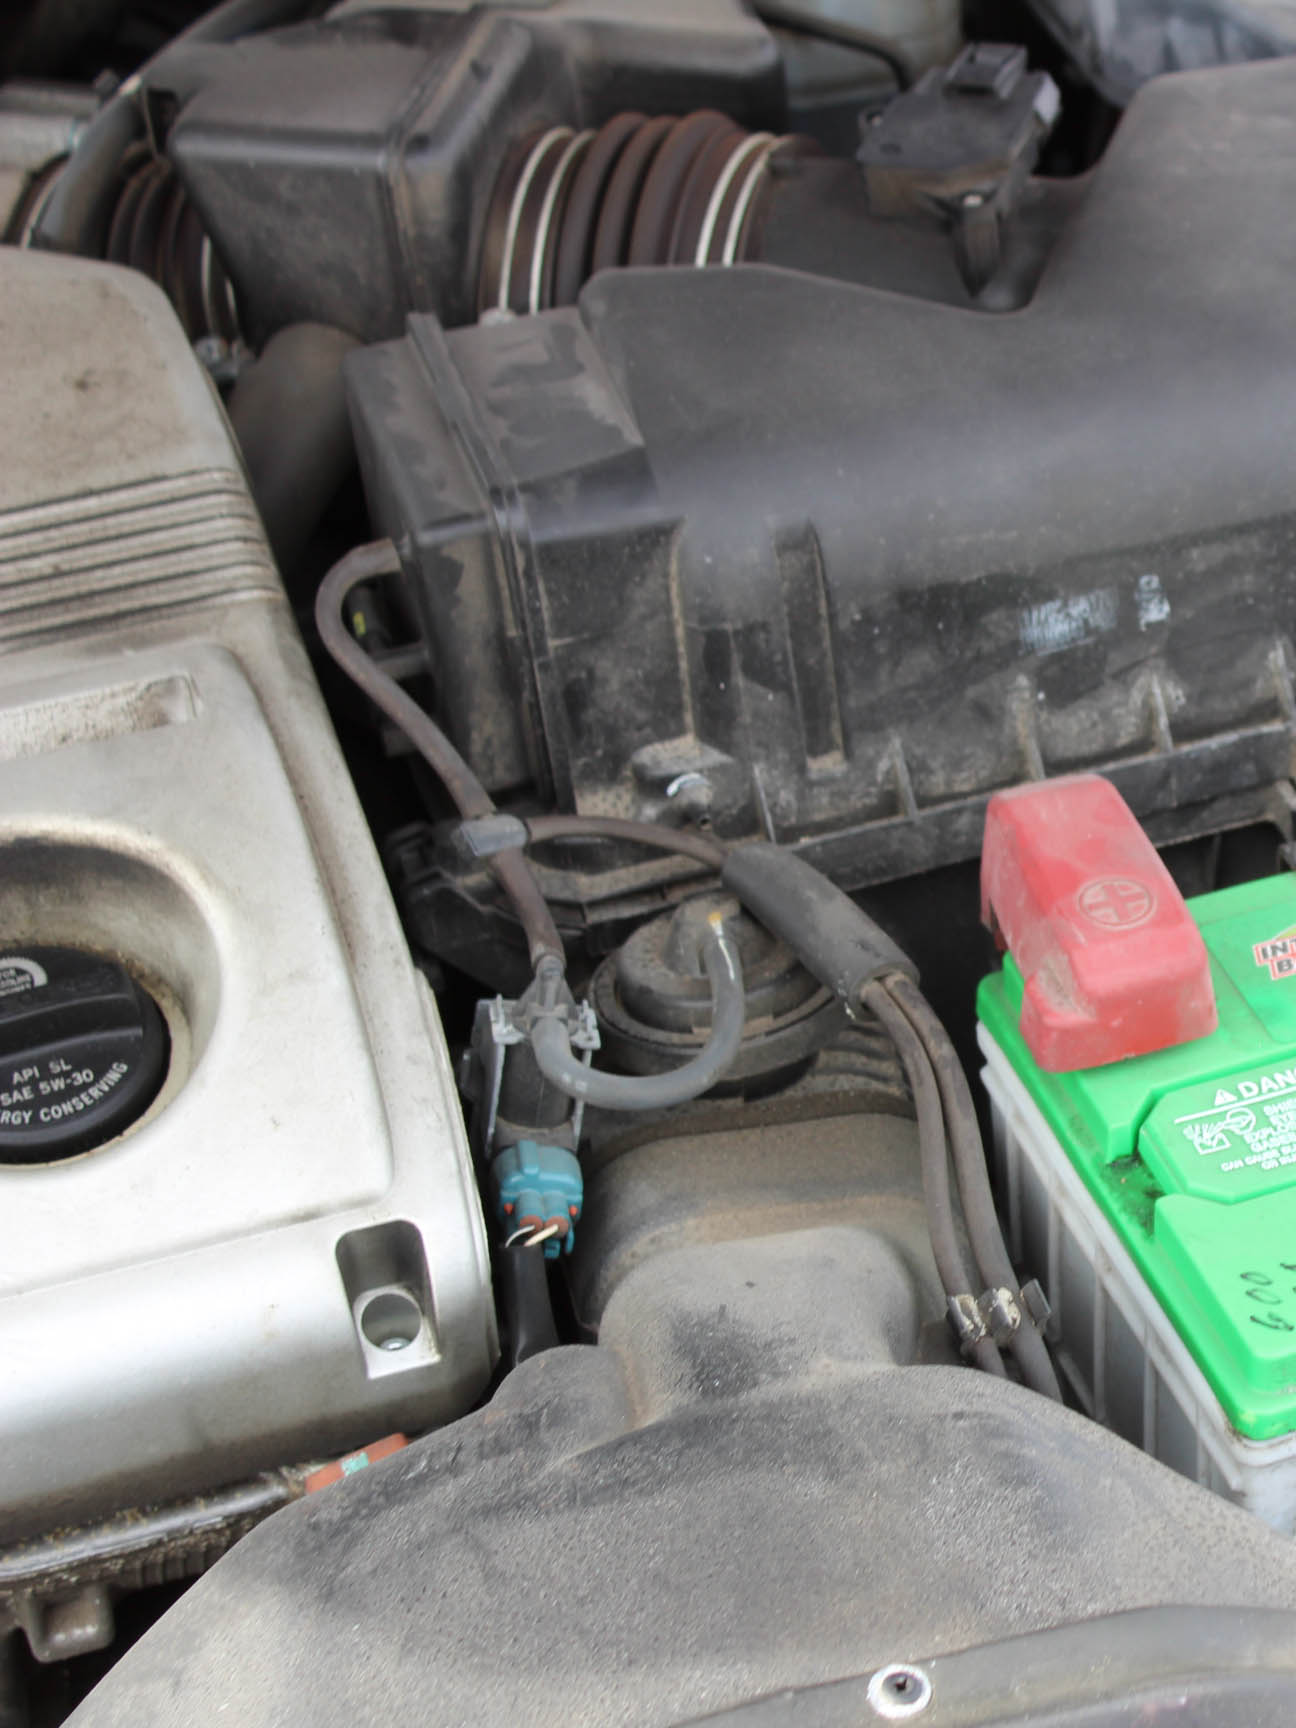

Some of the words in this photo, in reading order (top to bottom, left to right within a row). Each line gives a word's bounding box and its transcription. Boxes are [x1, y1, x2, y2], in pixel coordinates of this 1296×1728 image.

[0, 1085, 34, 1107] SAE
[39, 1068, 94, 1095] 5W-30
[12, 1065, 40, 1085] API
[48, 1057, 72, 1074] SL
[0, 1109, 33, 1125] RGY
[40, 1061, 128, 1122] CONSERVING
